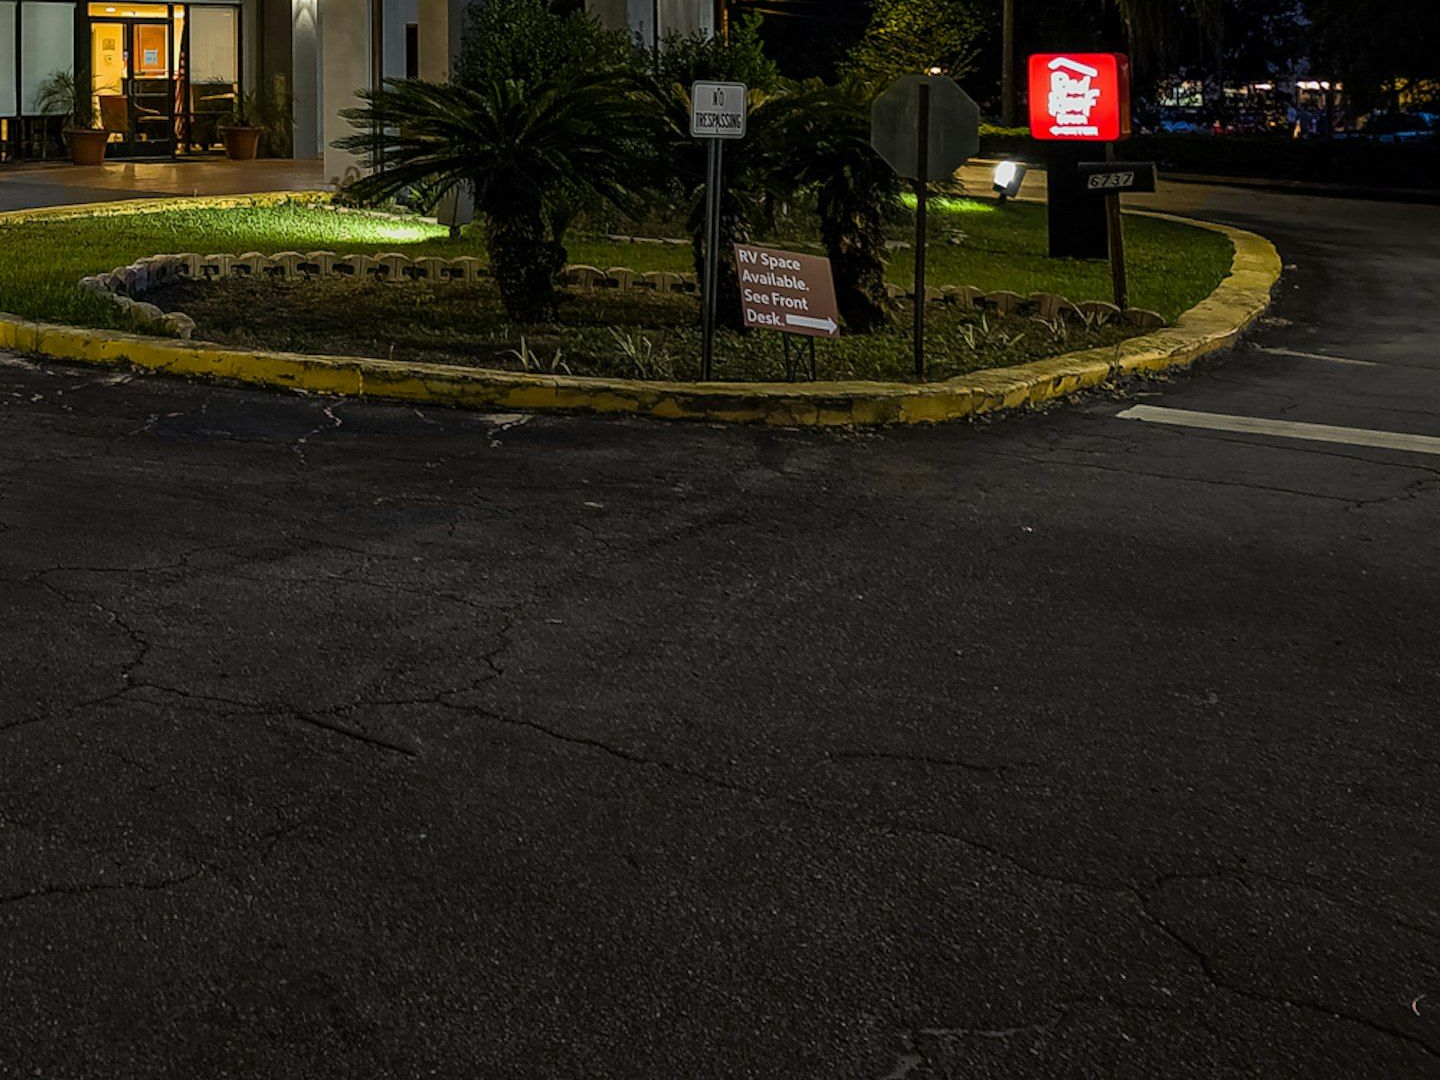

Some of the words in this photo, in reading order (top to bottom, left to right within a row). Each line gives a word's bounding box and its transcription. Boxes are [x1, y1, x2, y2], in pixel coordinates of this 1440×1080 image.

[712, 91, 725, 107] NO
[695, 112, 741, 128] TRESPASSING
[1090, 173, 1132, 187] 6737
[739, 248, 758, 264] RV
[760, 252, 801, 270] Space
[742, 268, 810, 292] Available.
[744, 288, 770, 305] See
[771, 291, 809, 311] Front
[746, 308, 786, 327] Desk.
